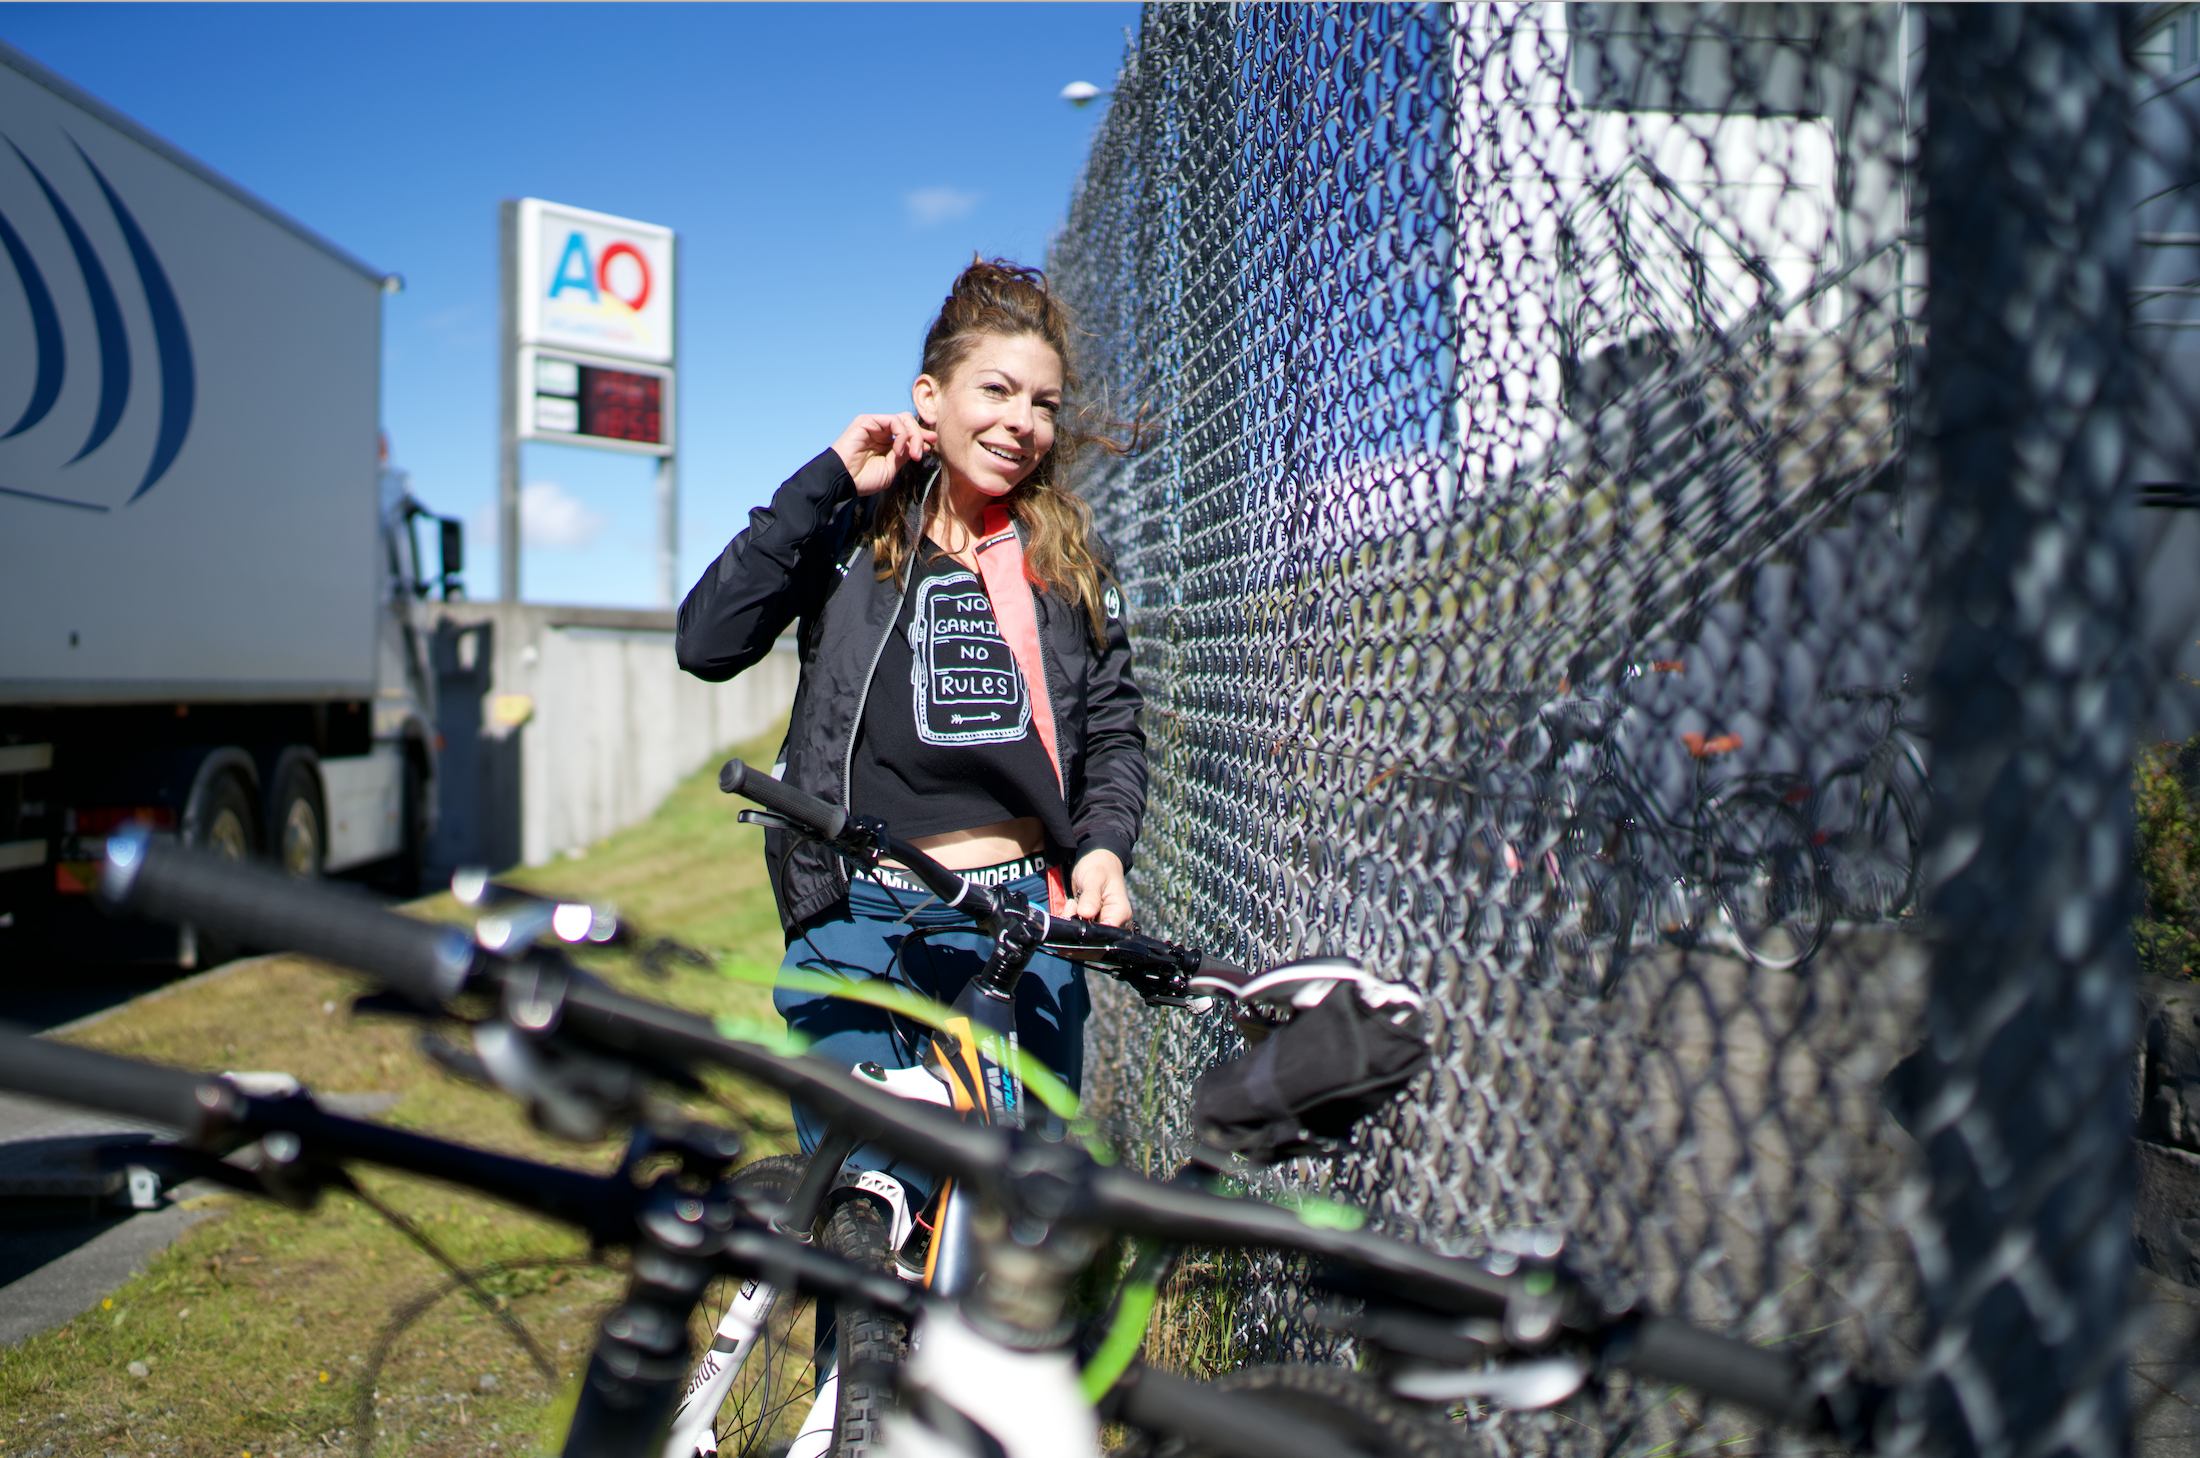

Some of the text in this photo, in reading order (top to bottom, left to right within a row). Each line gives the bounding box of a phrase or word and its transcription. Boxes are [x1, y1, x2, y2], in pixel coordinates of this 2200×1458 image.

[548, 231, 654, 313] AO
[957, 598, 988, 613] NO
[960, 645, 989, 661] NO
